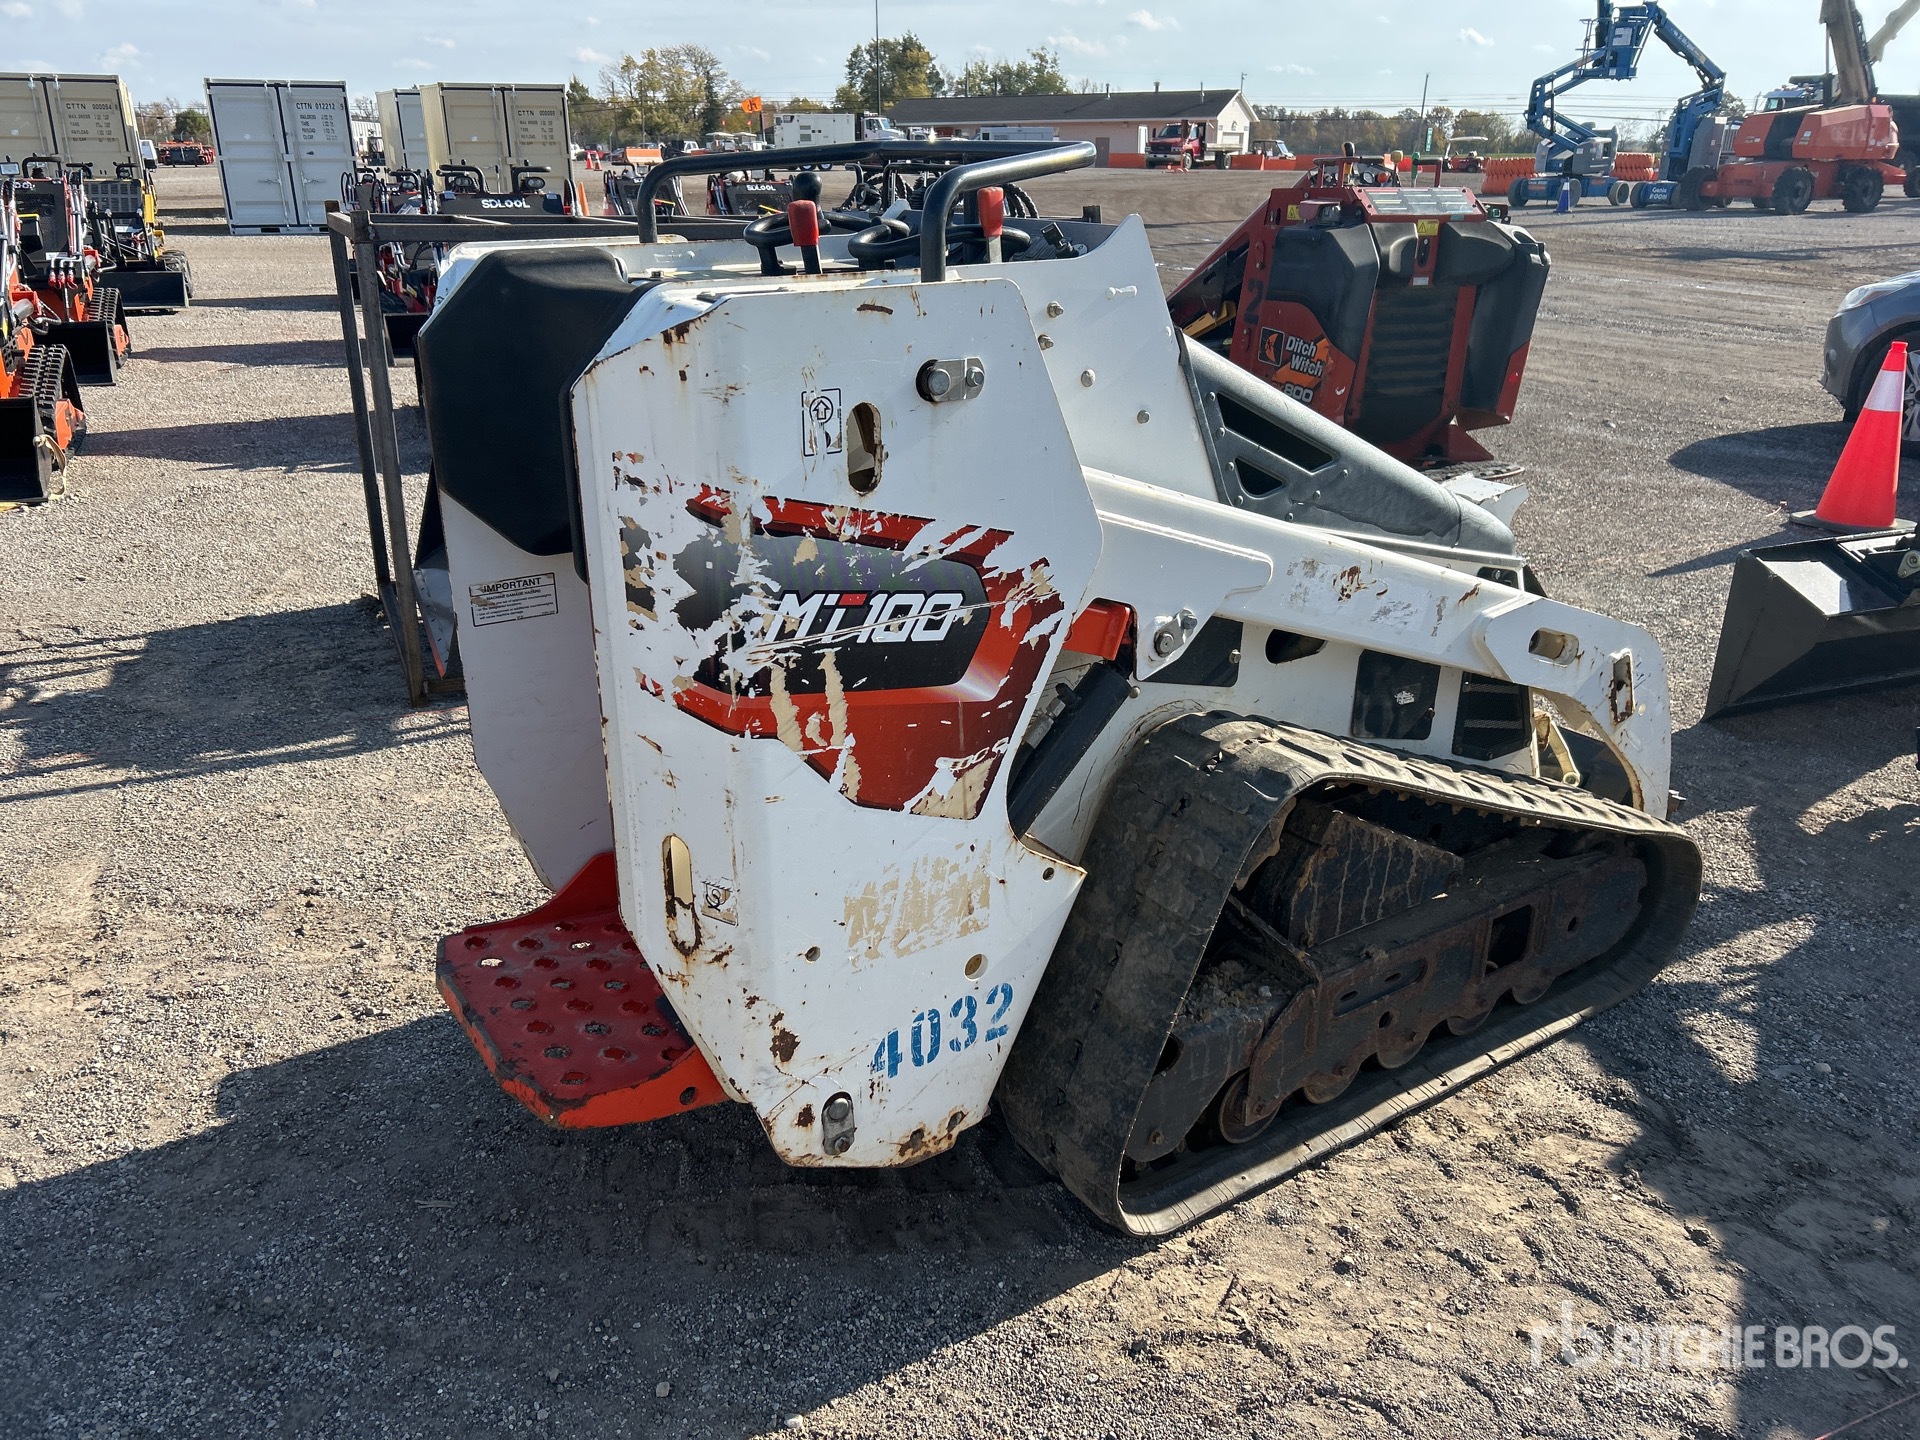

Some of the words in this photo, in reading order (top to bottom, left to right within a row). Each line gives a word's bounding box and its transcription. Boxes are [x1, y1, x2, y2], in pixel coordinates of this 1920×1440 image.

[481, 198, 530, 208] SDLOOL
[1285, 336, 1317, 357] Ditch
[1290, 354, 1323, 376] Witch
[484, 577, 541, 592] IMPORTANT
[766, 593, 964, 643] MT100
[868, 983, 1013, 1078] 4032
